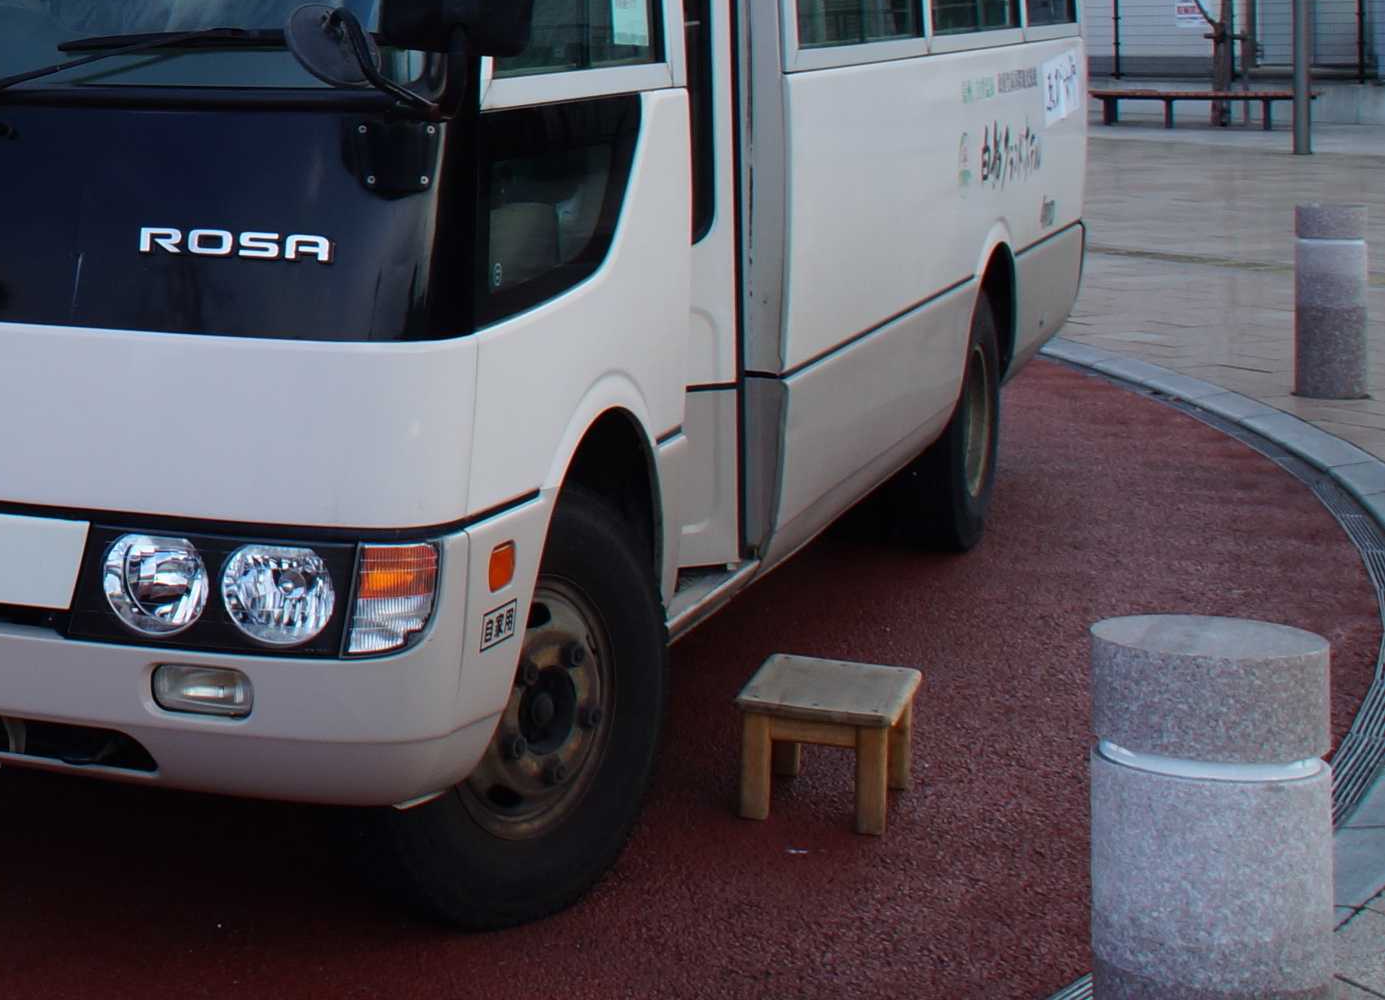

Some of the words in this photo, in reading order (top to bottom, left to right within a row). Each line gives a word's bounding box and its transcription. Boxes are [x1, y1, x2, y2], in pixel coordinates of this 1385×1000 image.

[139, 227, 331, 263] ROSA
[483, 606, 515, 644] 自家用
